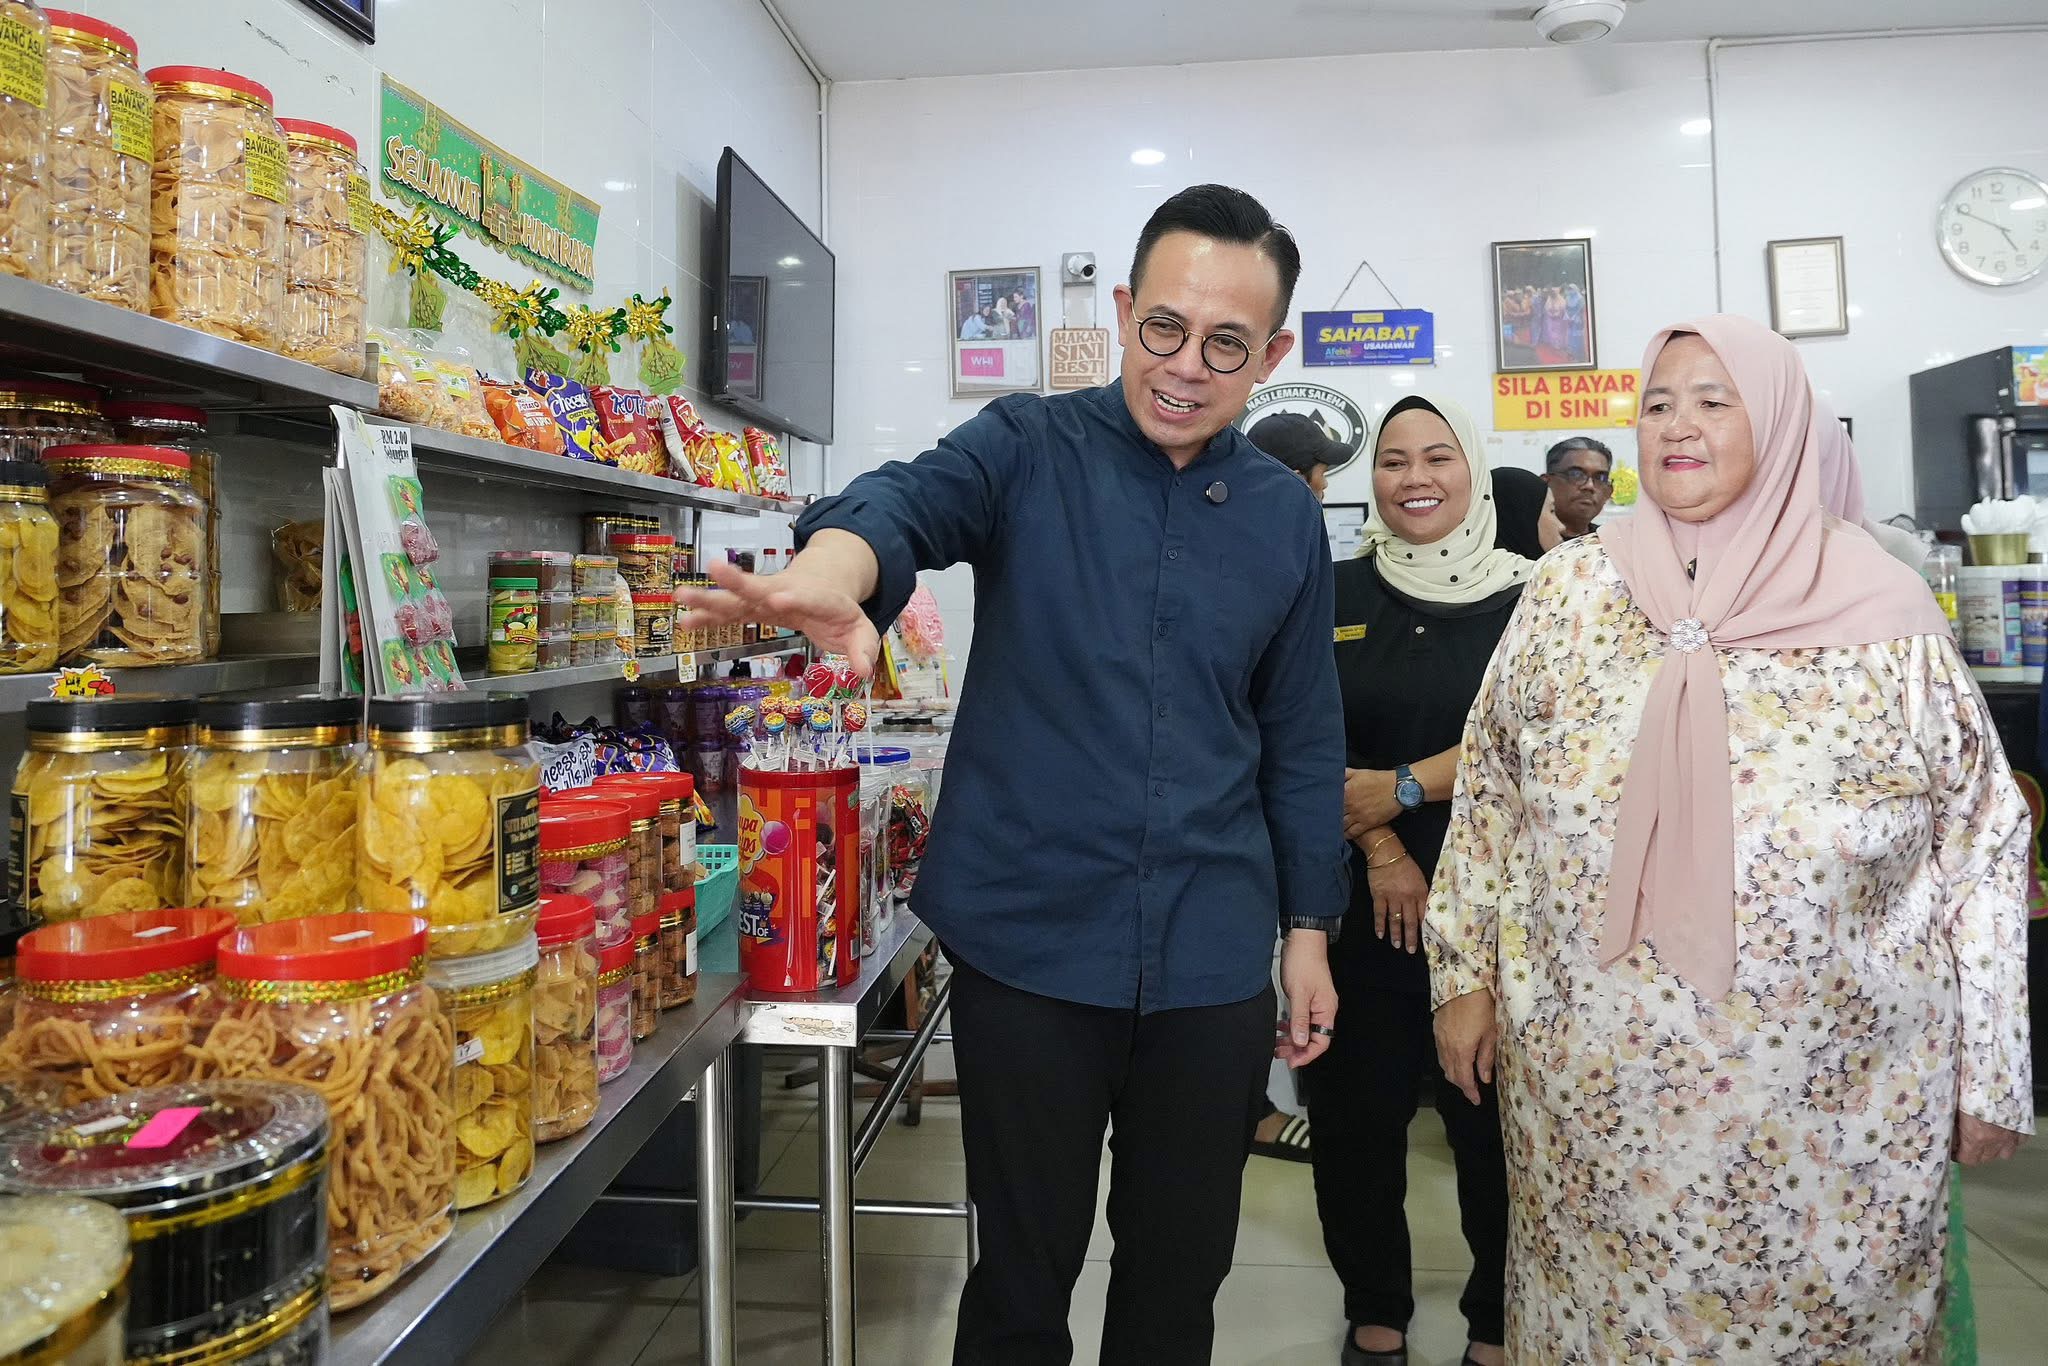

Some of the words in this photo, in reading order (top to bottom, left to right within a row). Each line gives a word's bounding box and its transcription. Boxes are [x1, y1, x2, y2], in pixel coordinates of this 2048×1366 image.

[384, 135, 481, 222] SELAMAT
[559, 231, 595, 280] RAYA
[1055, 332, 1104, 344] MAKAN
[1318, 325, 1421, 343] SAHABAT
[1055, 343, 1104, 361] SINI
[1363, 341, 1415, 350] USAHAWAN
[1498, 376, 1550, 396] SILA
[1559, 374, 1636, 394] BAYAR
[1245, 392, 1273, 411] NASI
[1271, 388, 1307, 402] LEMAK
[1307, 388, 1347, 411] SALEHA
[1526, 400, 1550, 419] DI
[1560, 399, 1608, 418] SINI
[757, 927, 769, 937] OF
